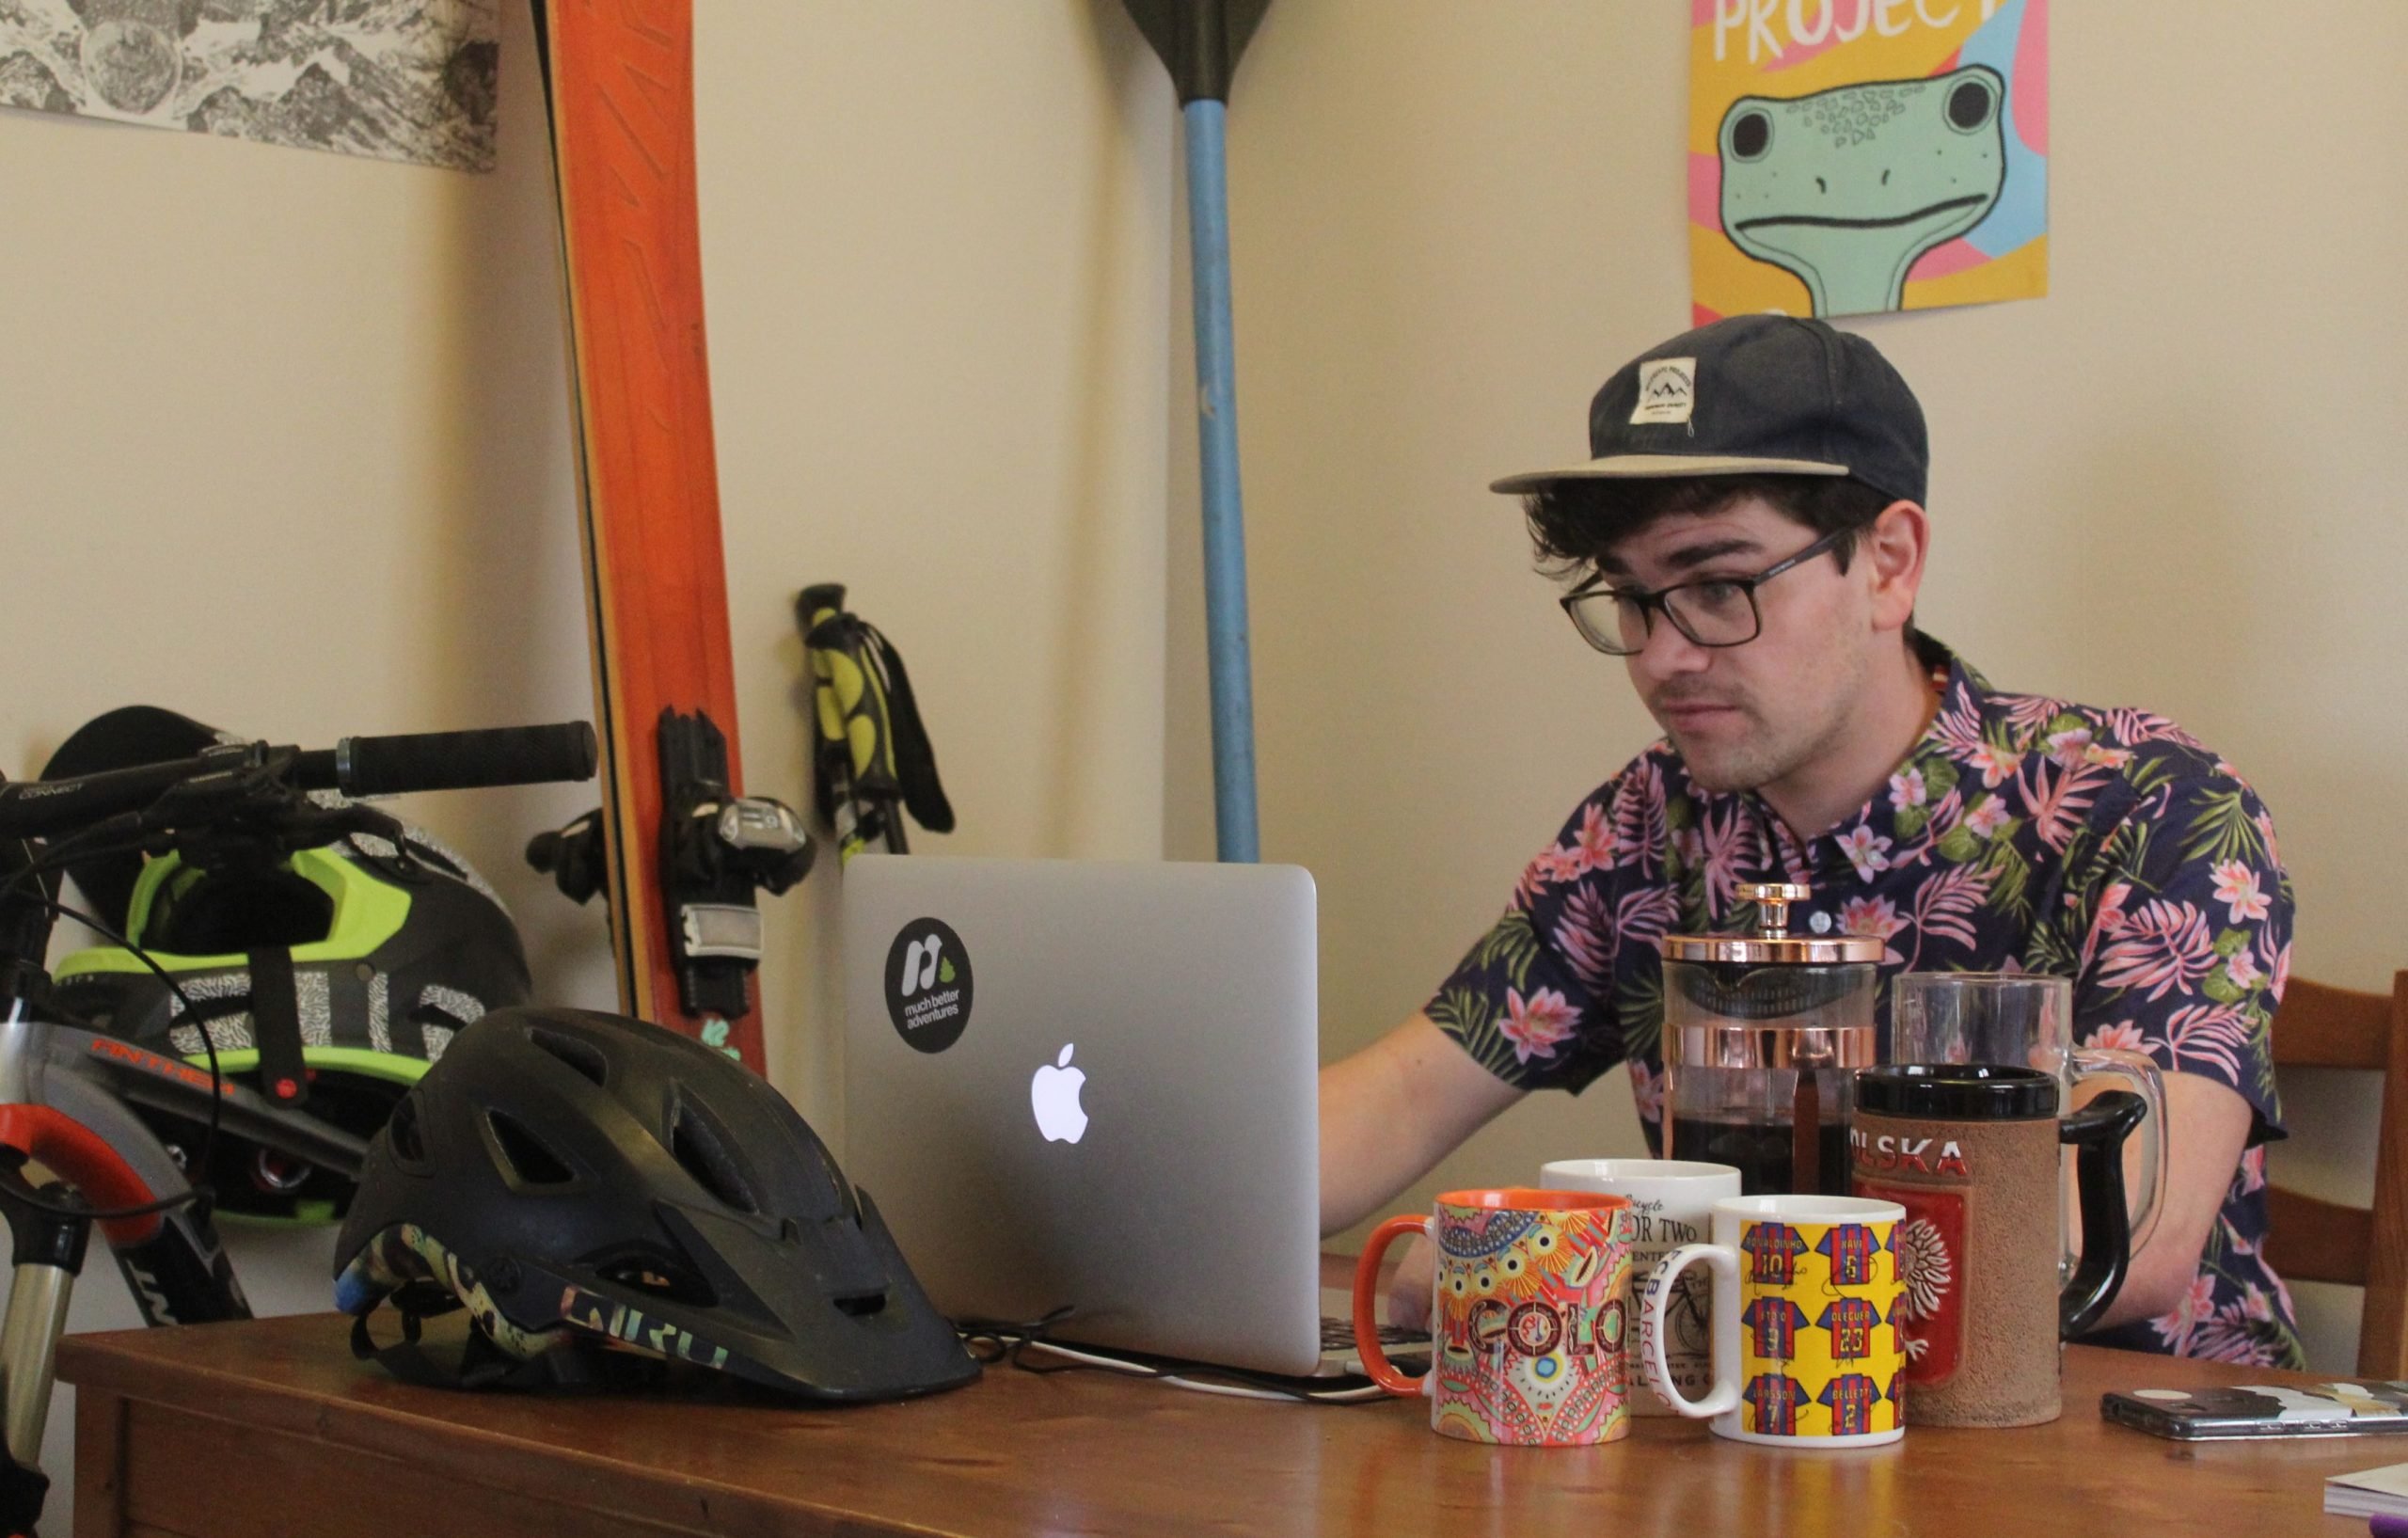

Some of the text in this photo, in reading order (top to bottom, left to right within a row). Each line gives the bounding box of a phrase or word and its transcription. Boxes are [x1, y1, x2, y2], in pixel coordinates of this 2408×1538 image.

[905, 990, 959, 1018] much better
[907, 1004, 959, 1030] adventures
[1632, 1214, 1698, 1243] OR TWO
[1746, 1237, 1803, 1250] RONALDINHO
[1762, 1254, 1783, 1278] 10
[1846, 1255, 1858, 1278] 6
[561, 1285, 729, 1371] GIRO
[1831, 1310, 1871, 1323] OLEGUER
[1752, 1388, 1797, 1401] LARSSON
[1832, 1387, 1873, 1401] BELLETTI
[1767, 1404, 1780, 1429] 7
[1845, 1403, 1857, 1429] 2
